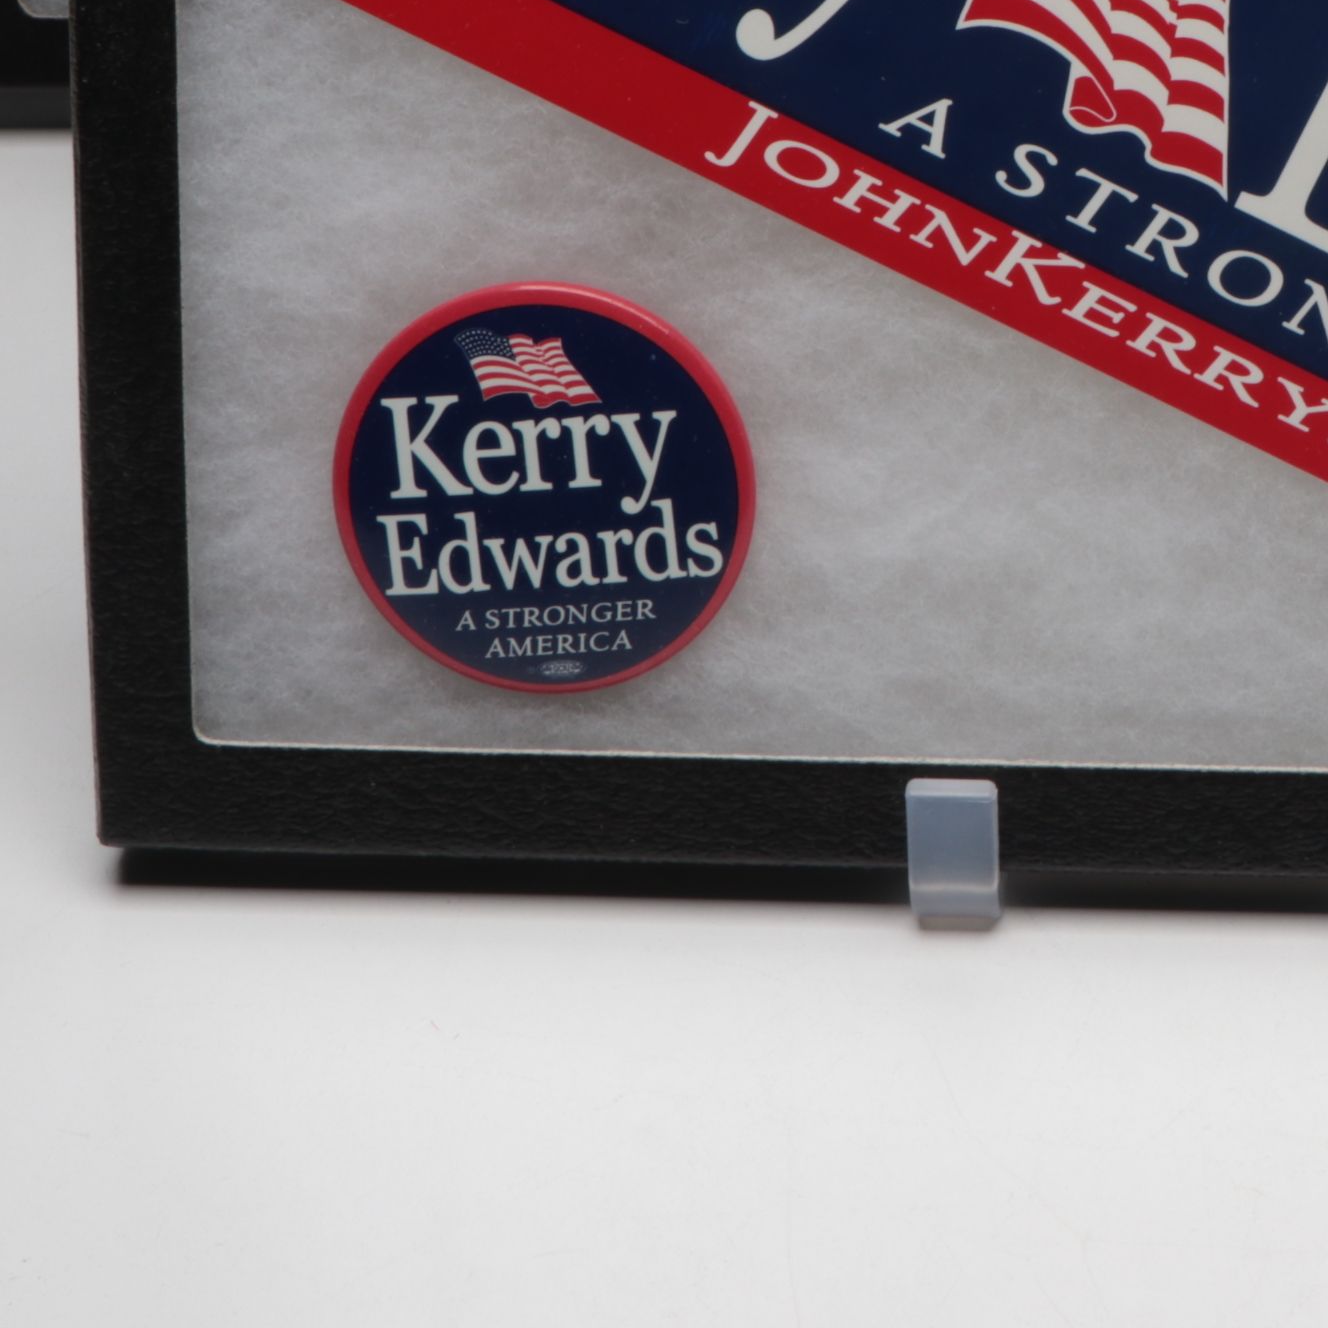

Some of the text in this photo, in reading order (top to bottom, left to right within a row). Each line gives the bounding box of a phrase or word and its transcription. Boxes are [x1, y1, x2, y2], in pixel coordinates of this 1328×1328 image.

[878, 98, 953, 158] A
[380, 394, 677, 515] Kerry
[376, 498, 723, 597] Edwards
[455, 599, 656, 632] A STRONGER
[484, 629, 633, 659] AMERICA
